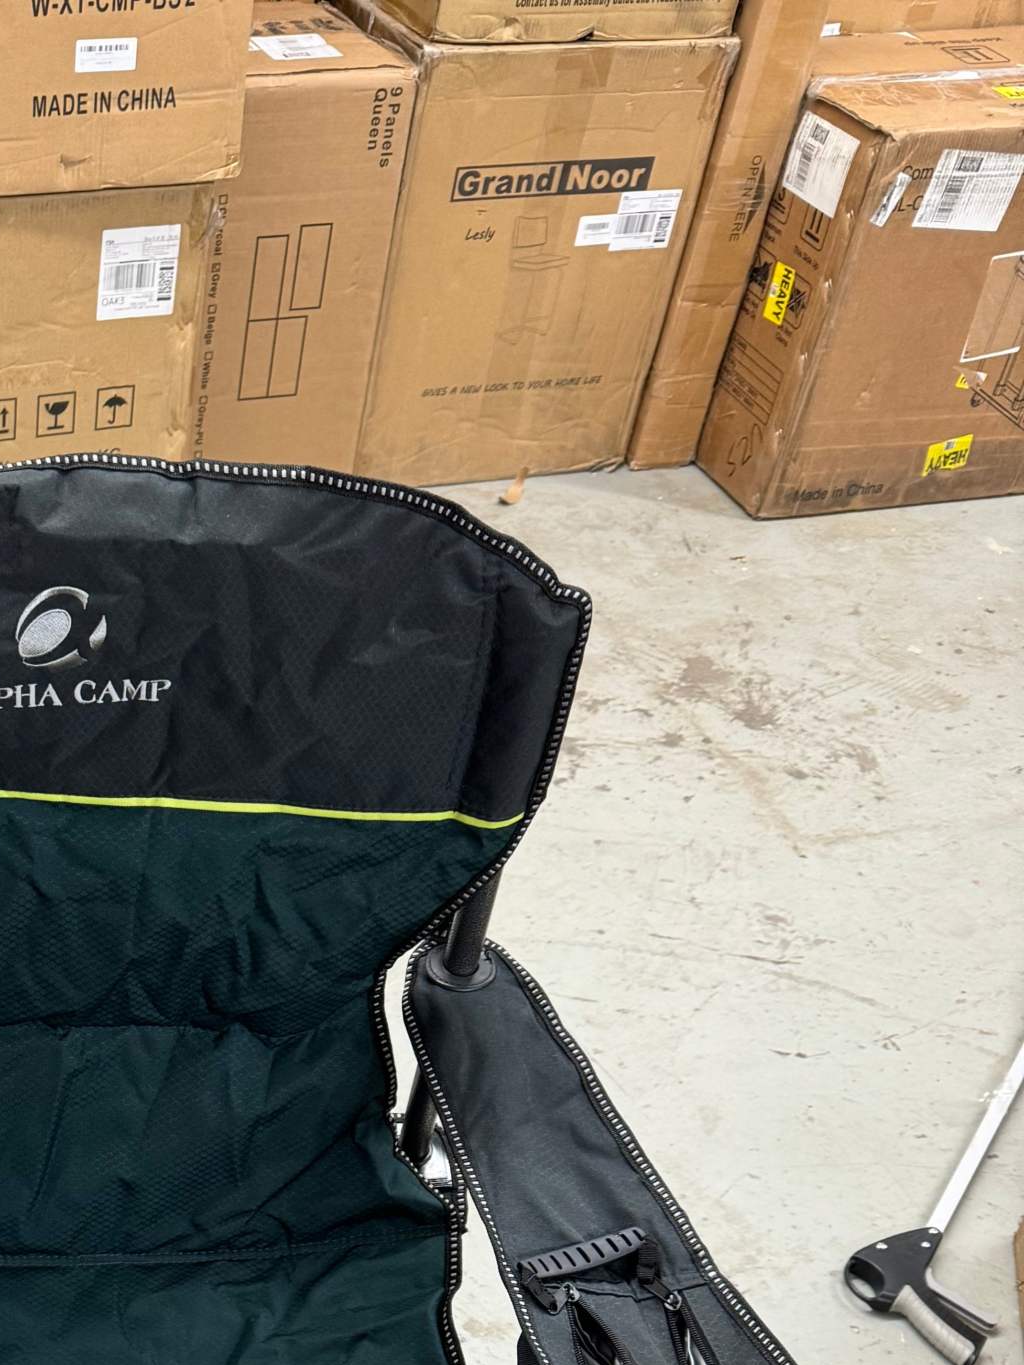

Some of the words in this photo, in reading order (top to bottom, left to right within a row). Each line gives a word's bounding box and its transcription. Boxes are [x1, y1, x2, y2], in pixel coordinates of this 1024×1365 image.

[32, 93, 88, 118] MADE
[93, 91, 112, 114] IN
[116, 86, 177, 112] CHINA
[390, 86, 403, 97] 9
[367, 88, 388, 150] Queen
[379, 103, 400, 168] Panels
[457, 166, 559, 197] Grand
[565, 163, 648, 192] Noor
[742, 155, 762, 197] OPEN
[465, 226, 496, 241] Lesly
[208, 273, 221, 299] Grey
[772, 268, 794, 321] HEAVY
[460, 385, 482, 394] NEW
[484, 383, 509, 392] LOOK
[512, 381, 525, 390] TO
[527, 380, 553, 389] YOUR
[555, 377, 582, 386] HOME
[584, 375, 603, 384] LIFE
[926, 448, 969, 472] HEAVY
[794, 487, 828, 501] Made
[832, 486, 843, 497] in
[847, 482, 884, 496] China
[74, 679, 172, 705] CAMP
